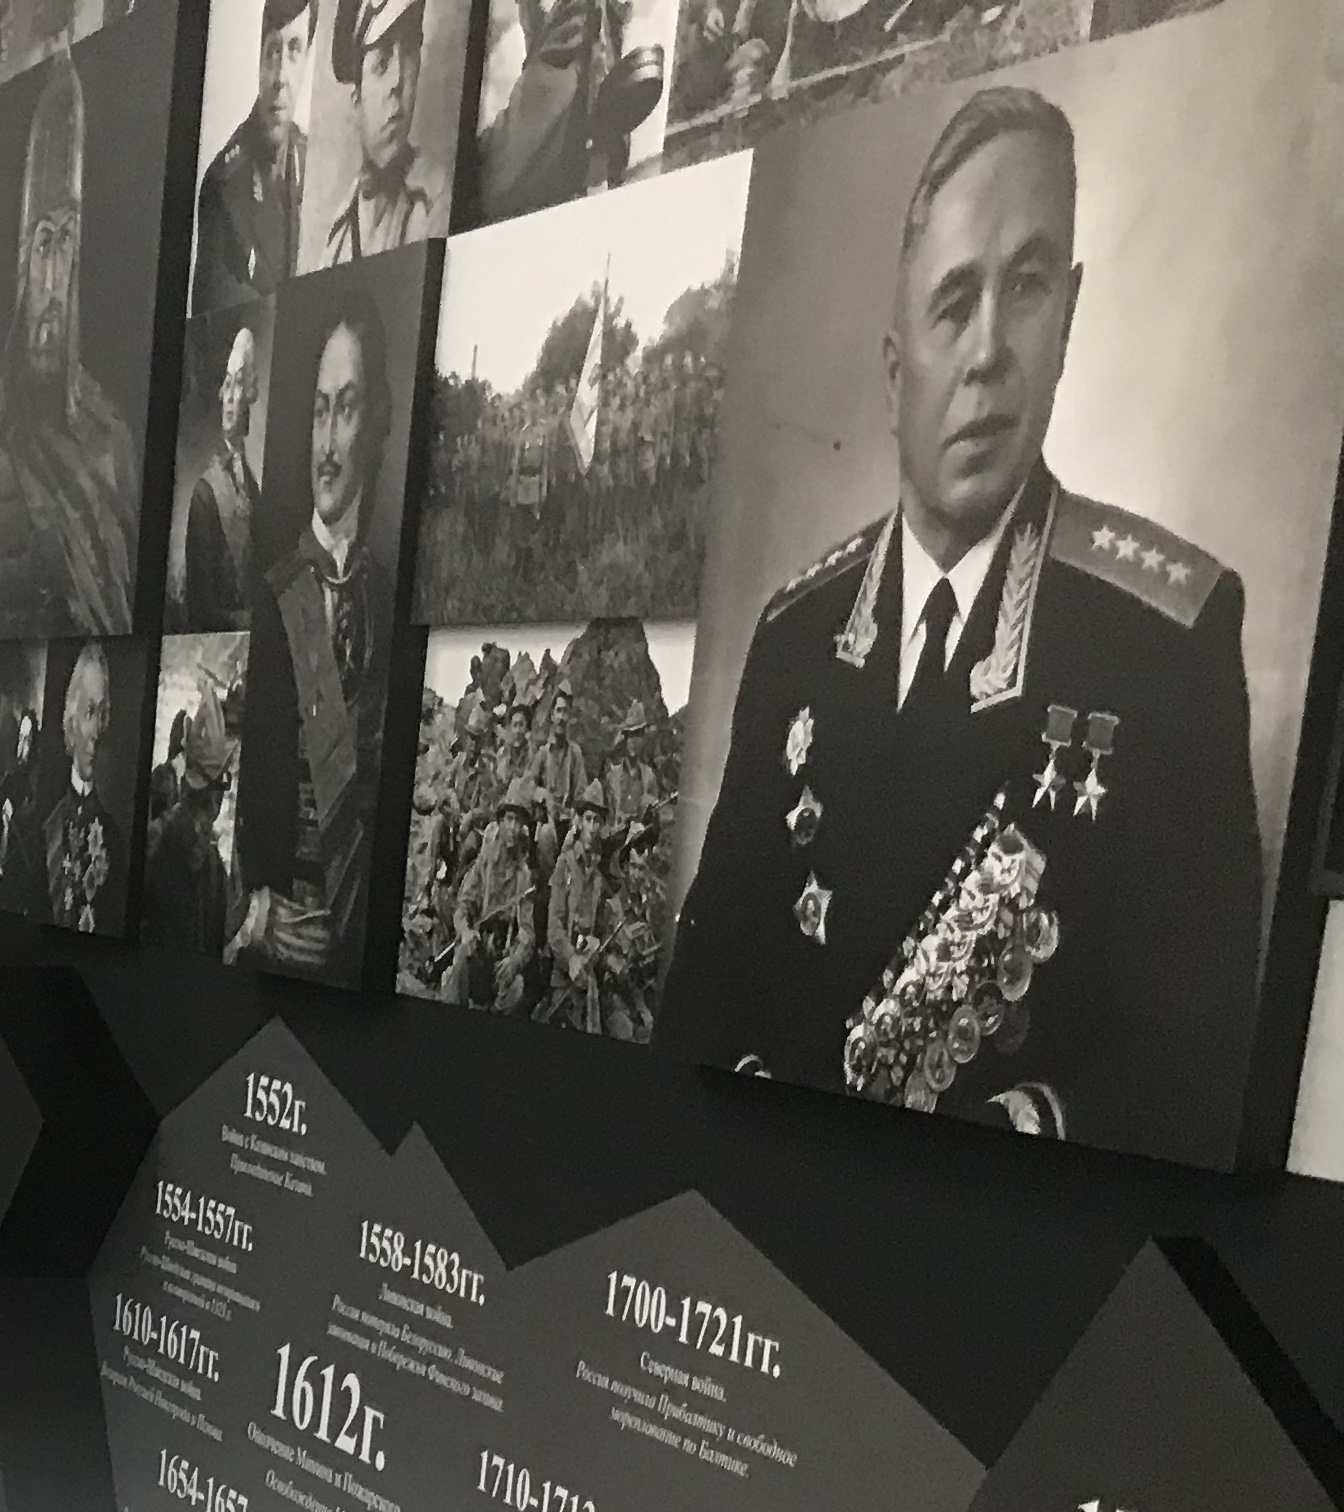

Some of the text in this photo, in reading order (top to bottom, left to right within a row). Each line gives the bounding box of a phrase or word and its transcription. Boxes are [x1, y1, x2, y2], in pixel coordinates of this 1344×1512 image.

[243, 1071, 308, 1136] 1552г.
[154, 1180, 254, 1252] 1554-1557гг.
[359, 1219, 486, 1307] 1558-1583гг.
[112, 1291, 220, 1383] 1610-1617гг.
[604, 1269, 781, 1379] 1700-1721гг.
[269, 1341, 387, 1473] 1612г.
